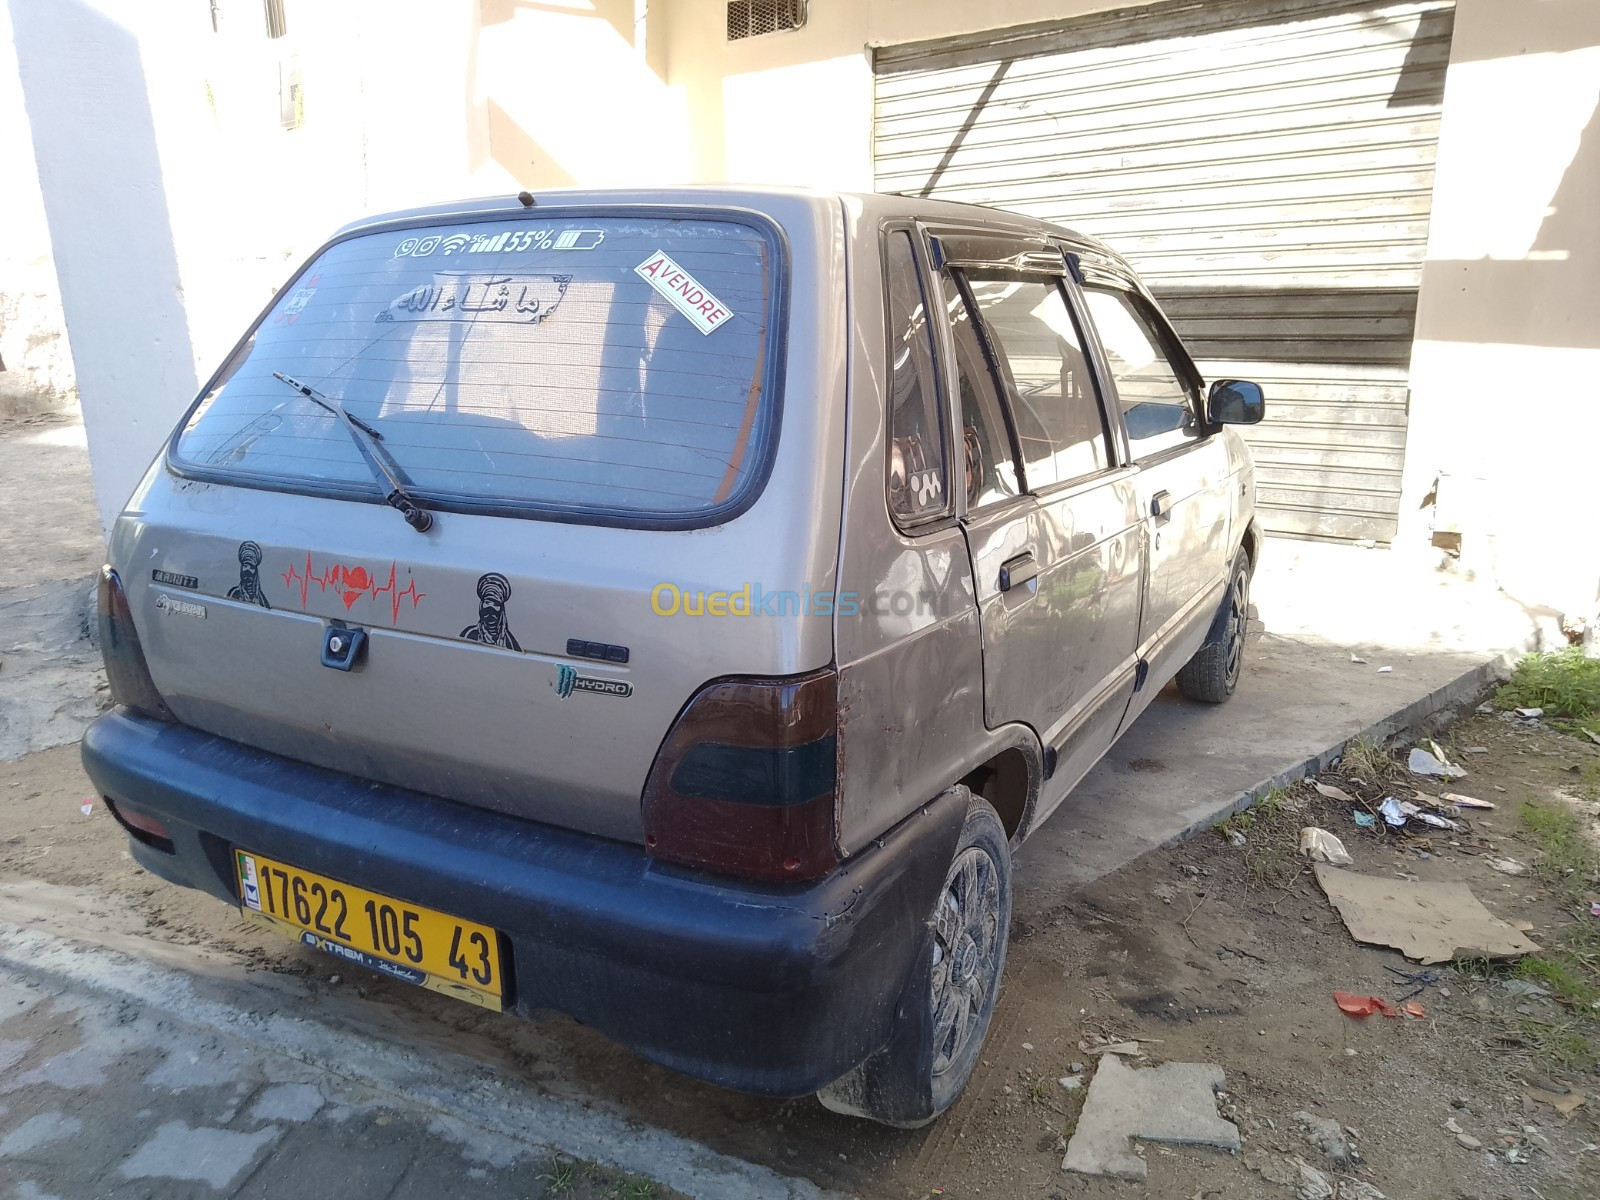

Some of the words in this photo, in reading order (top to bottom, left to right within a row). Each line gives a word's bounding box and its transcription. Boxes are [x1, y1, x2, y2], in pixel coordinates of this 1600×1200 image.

[505, 229, 554, 252] 55%
[575, 679, 627, 693] HYDRO
[260, 865, 352, 942] 17622
[365, 899, 423, 963] 105
[449, 925, 492, 985] 43
